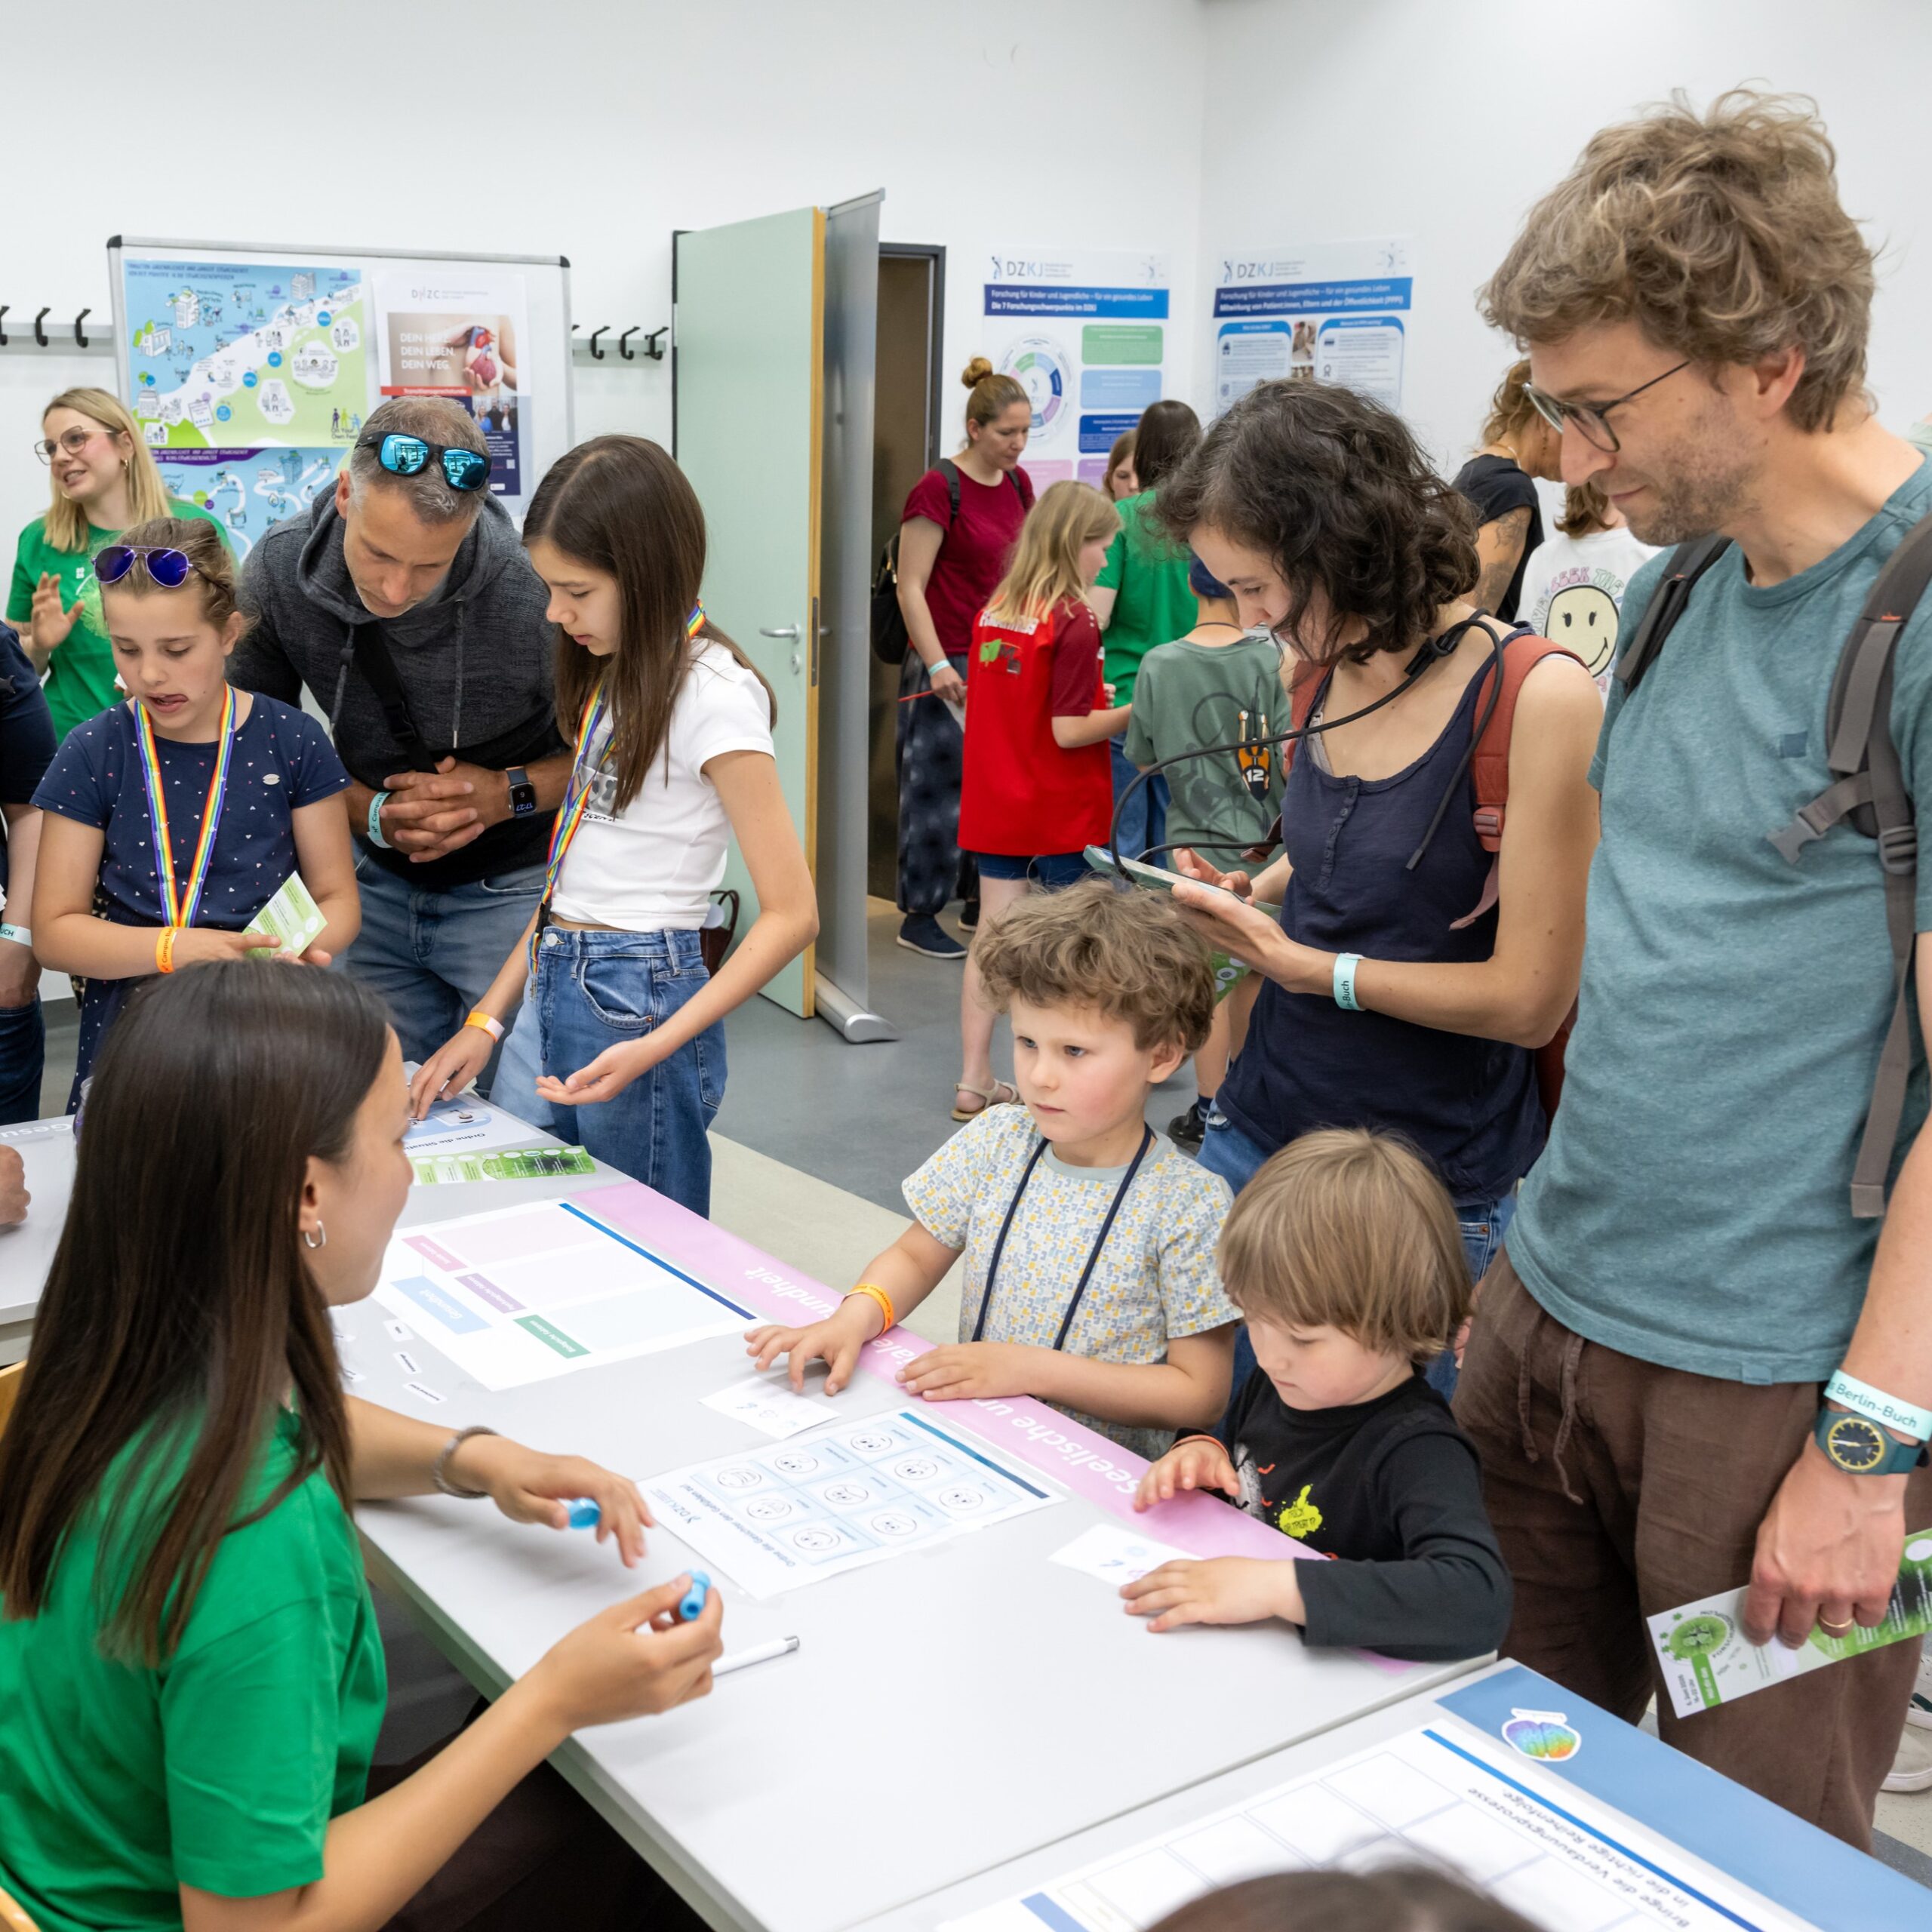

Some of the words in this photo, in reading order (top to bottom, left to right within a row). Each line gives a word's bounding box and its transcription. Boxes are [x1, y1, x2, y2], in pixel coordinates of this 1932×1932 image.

[1007, 260, 1043, 277] DZKJ
[1237, 263, 1274, 278] DZKJ
[992, 290, 1020, 300] Forschung
[1029, 291, 1047, 299] Kinder
[1220, 292, 1247, 300] Forschung
[991, 301, 1001, 309] Die
[400, 333, 423, 343] DEIN
[401, 346, 423, 355] DEIN
[401, 359, 424, 369] DEIN
[1246, 768, 1265, 783] 12
[1835, 1383, 1918, 1429] Berlin-Buch
[1011, 1416, 1142, 1494] Seelische
[1503, 1789, 1586, 1844] Reihenfolge.
[1468, 1787, 1609, 1879] Verdauungsprozesse
[1587, 1842, 1644, 1880] richtige
[1613, 1877, 1637, 1894] die
[1645, 1878, 1670, 1896] die
[1672, 1894, 1690, 1909] in
[1639, 1894, 1690, 1928] Bringe
